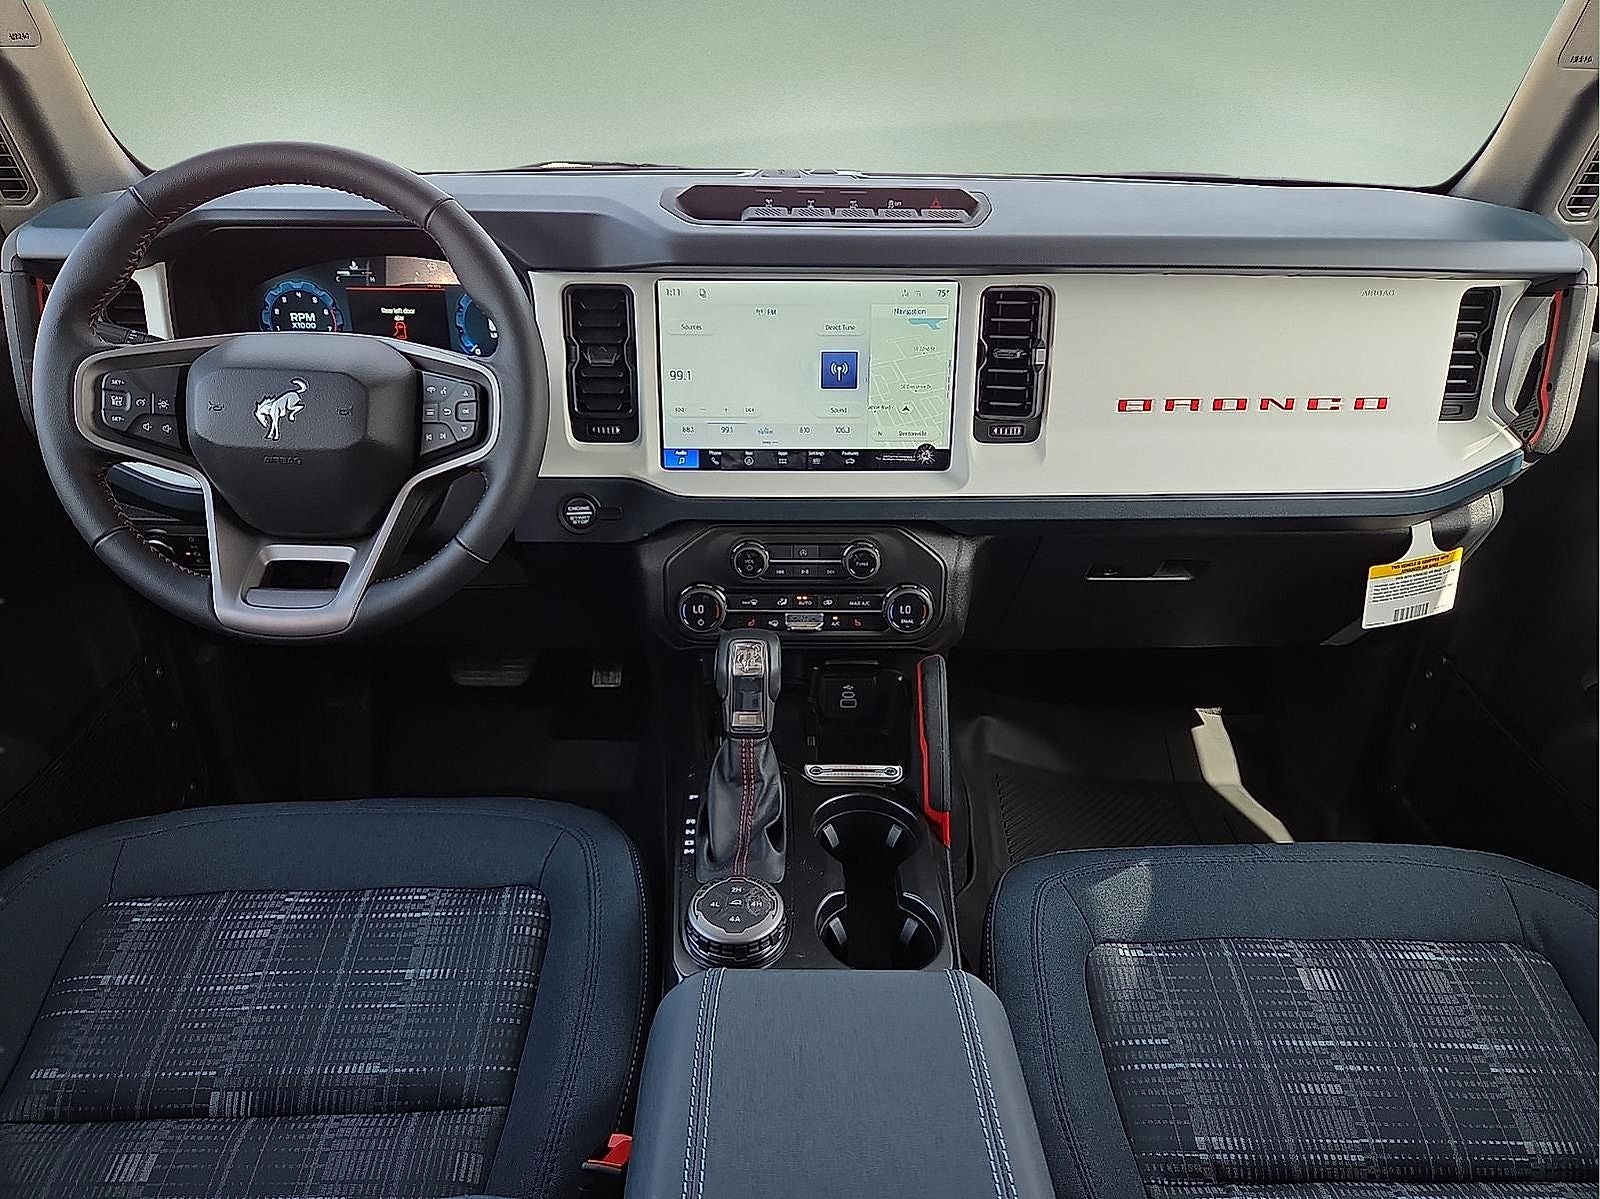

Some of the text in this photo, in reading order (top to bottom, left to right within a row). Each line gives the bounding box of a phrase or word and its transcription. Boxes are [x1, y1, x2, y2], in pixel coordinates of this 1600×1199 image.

[289, 312, 316, 322] RPM
[669, 369, 692, 381] 99.1
[1117, 396, 1390, 413] BRONCO
[830, 406, 848, 414] Sound
[692, 604, 705, 615] LO
[899, 605, 912, 615] LO
[730, 886, 743, 894] 2H
[728, 915, 741, 923] 4A
